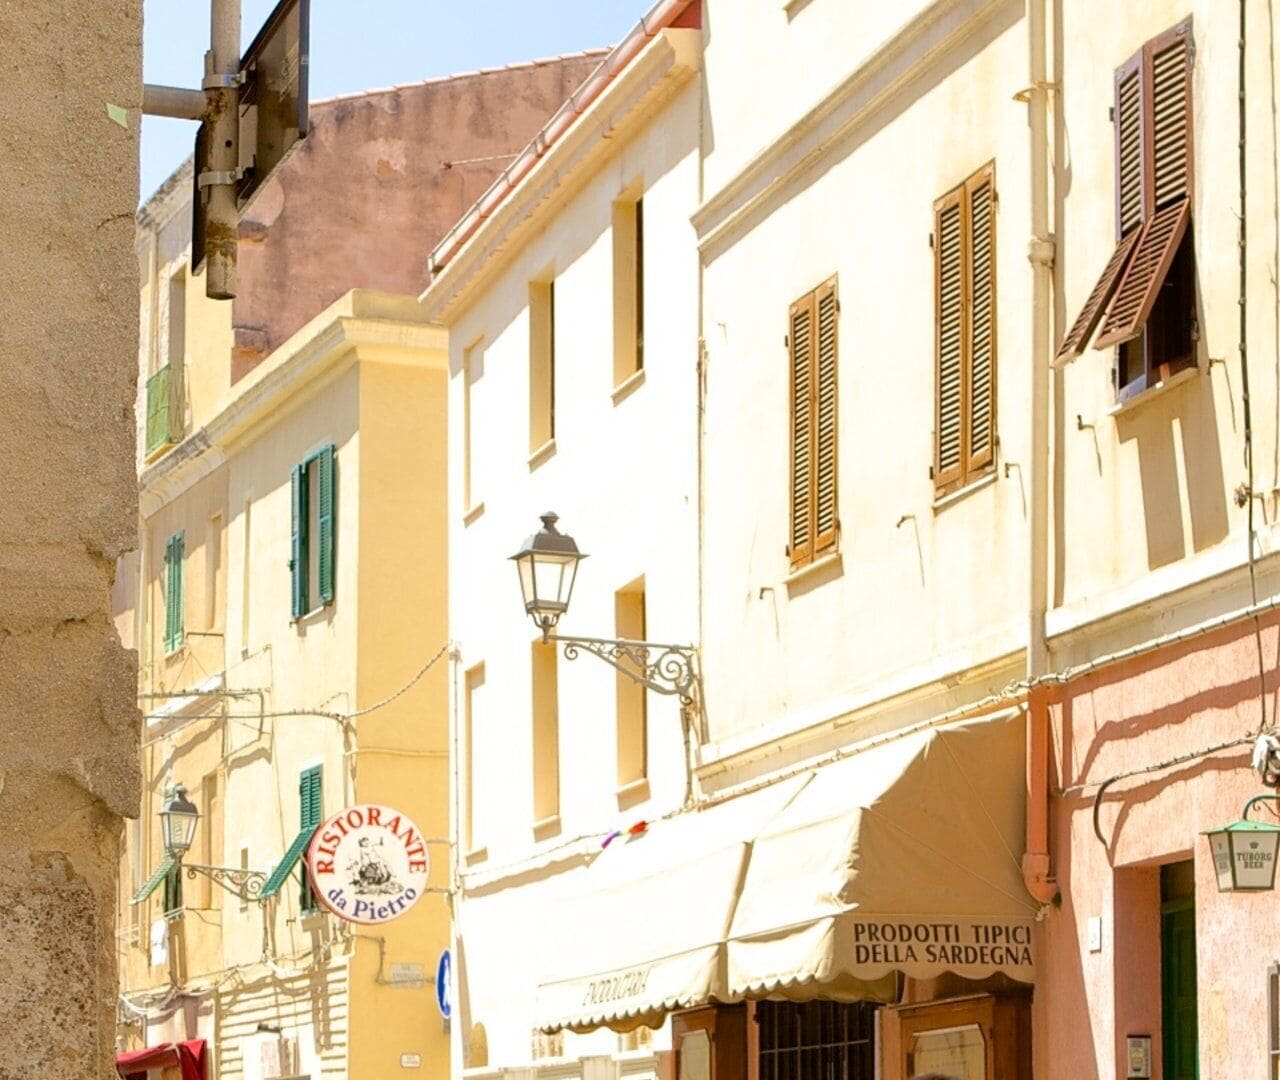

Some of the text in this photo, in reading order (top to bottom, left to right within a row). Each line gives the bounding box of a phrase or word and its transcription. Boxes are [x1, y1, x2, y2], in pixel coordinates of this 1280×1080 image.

[317, 807, 426, 874] RISTORANTE
[1237, 852, 1272, 862] TUBORG
[328, 887, 417, 920] da Pietro
[854, 923, 1031, 944] PRODOTTI TIPICI
[856, 944, 1033, 966] DELLA SARDEGNA
